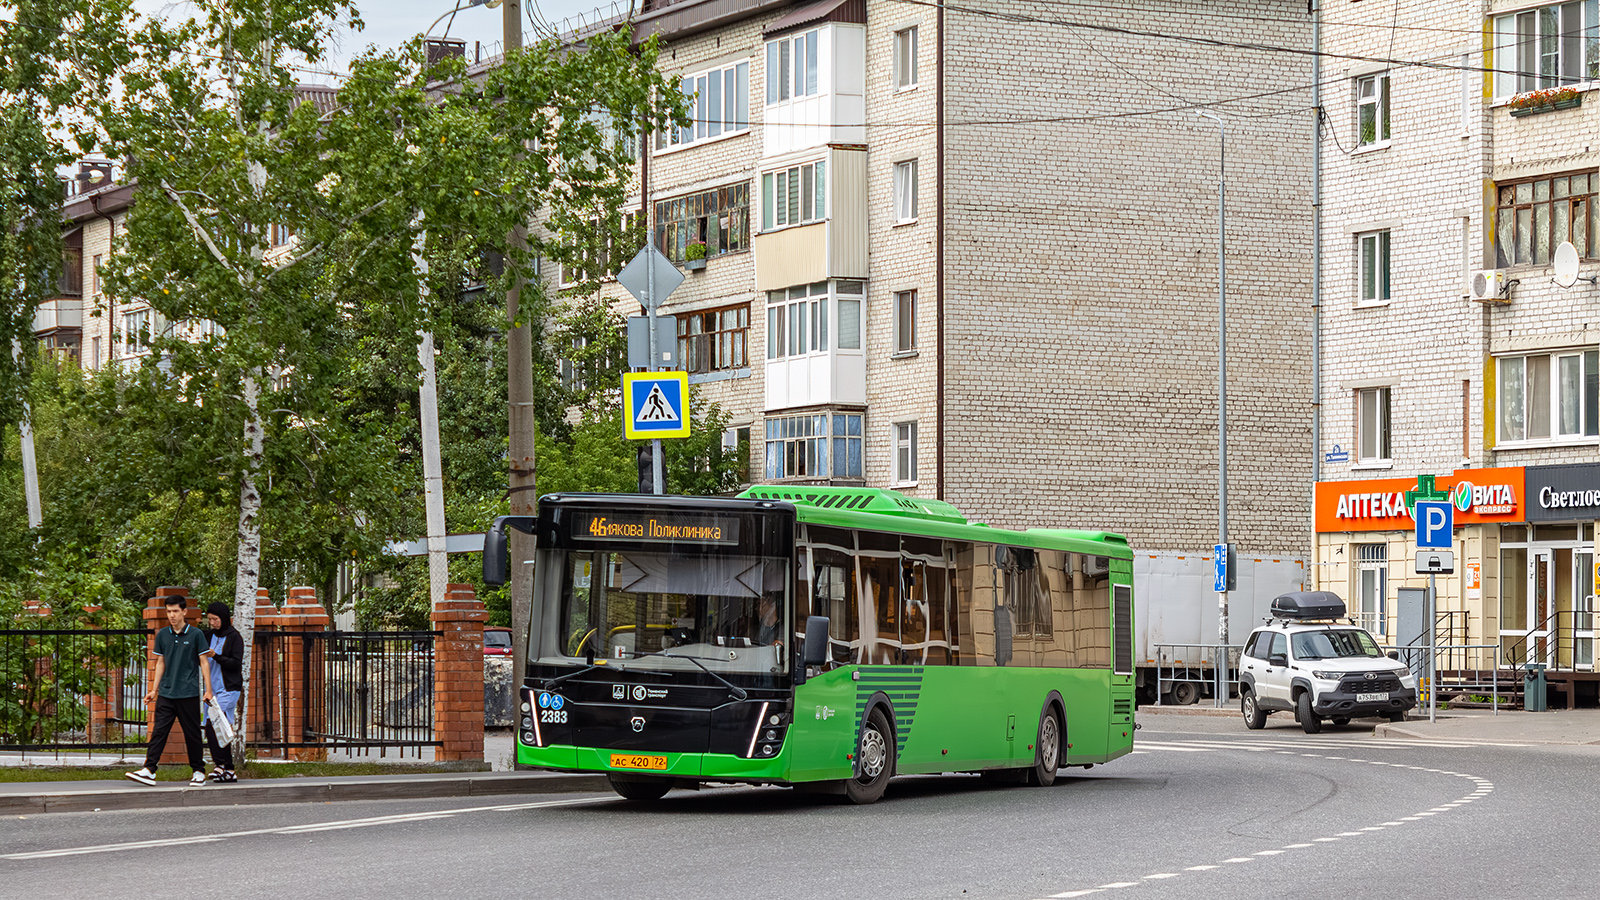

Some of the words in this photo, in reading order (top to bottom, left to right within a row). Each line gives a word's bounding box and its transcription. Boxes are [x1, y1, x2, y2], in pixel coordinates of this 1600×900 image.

[1335, 491, 1407, 519] АПТЕКА
[1472, 484, 1513, 506] ВИТА
[1540, 486, 1600, 509] Светлое
[1474, 505, 1512, 513] ЭКСПРЕСС
[589, 517, 607, 537] 46
[649, 519, 721, 540] Поликлиника
[541, 710, 568, 723] 2383
[615, 758, 627, 767] АС
[631, 757, 649, 768] 420
[654, 757, 664, 766] 72
